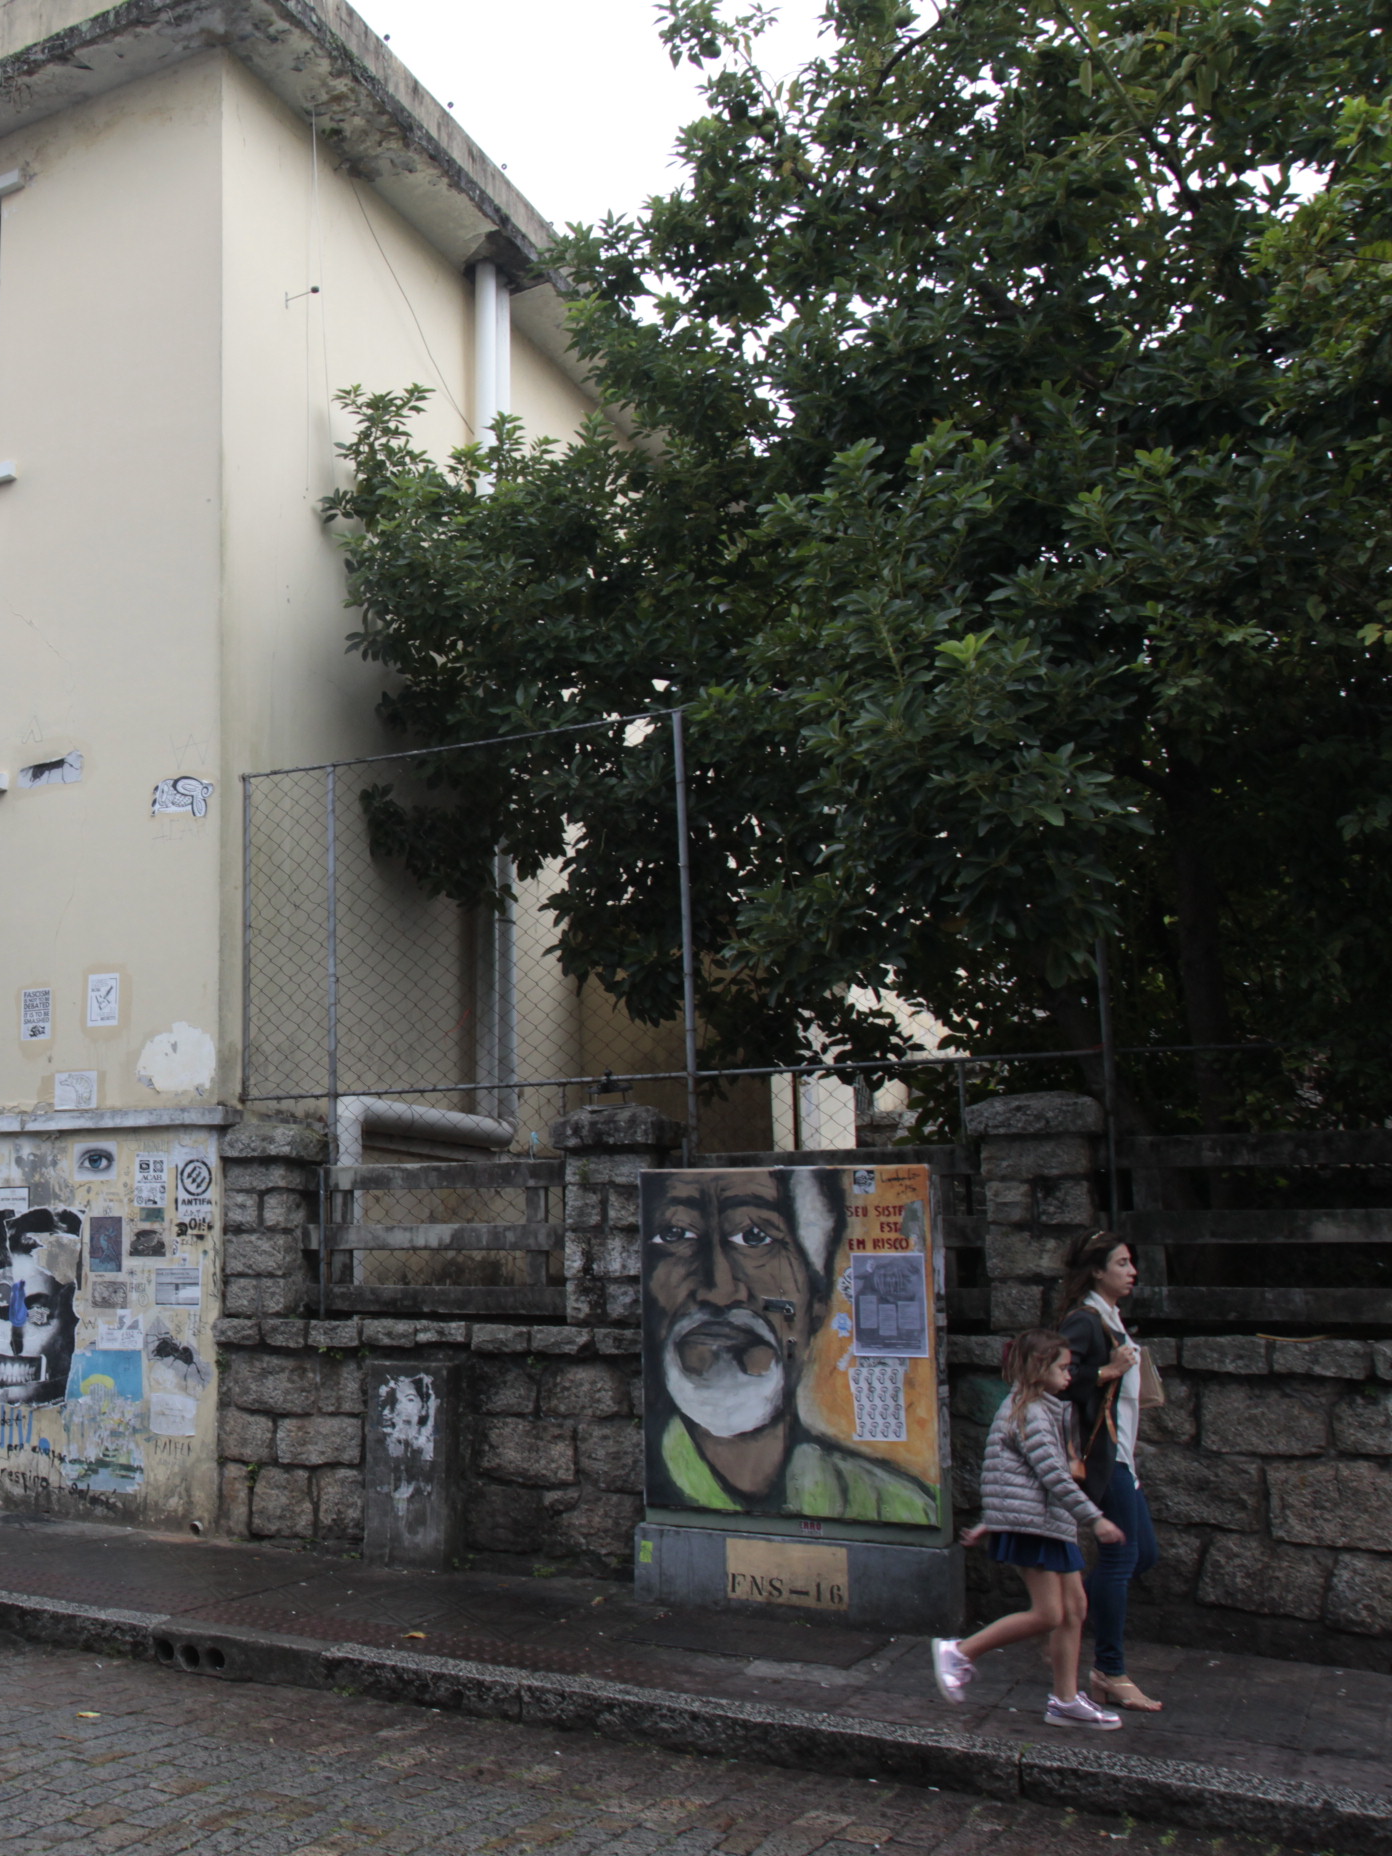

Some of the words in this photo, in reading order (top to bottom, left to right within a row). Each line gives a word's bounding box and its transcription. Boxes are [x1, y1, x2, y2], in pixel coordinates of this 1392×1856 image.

[24, 990, 50, 998] FASCISM
[24, 1002, 50, 1010] DEBATED
[181, 1198, 213, 1206] ANTIFA
[846, 1205, 868, 1217] SEU
[874, 1205, 906, 1217] SISTE
[880, 1222, 902, 1233] EST
[848, 1239, 866, 1250] EM
[872, 1238, 909, 1250] RISCO
